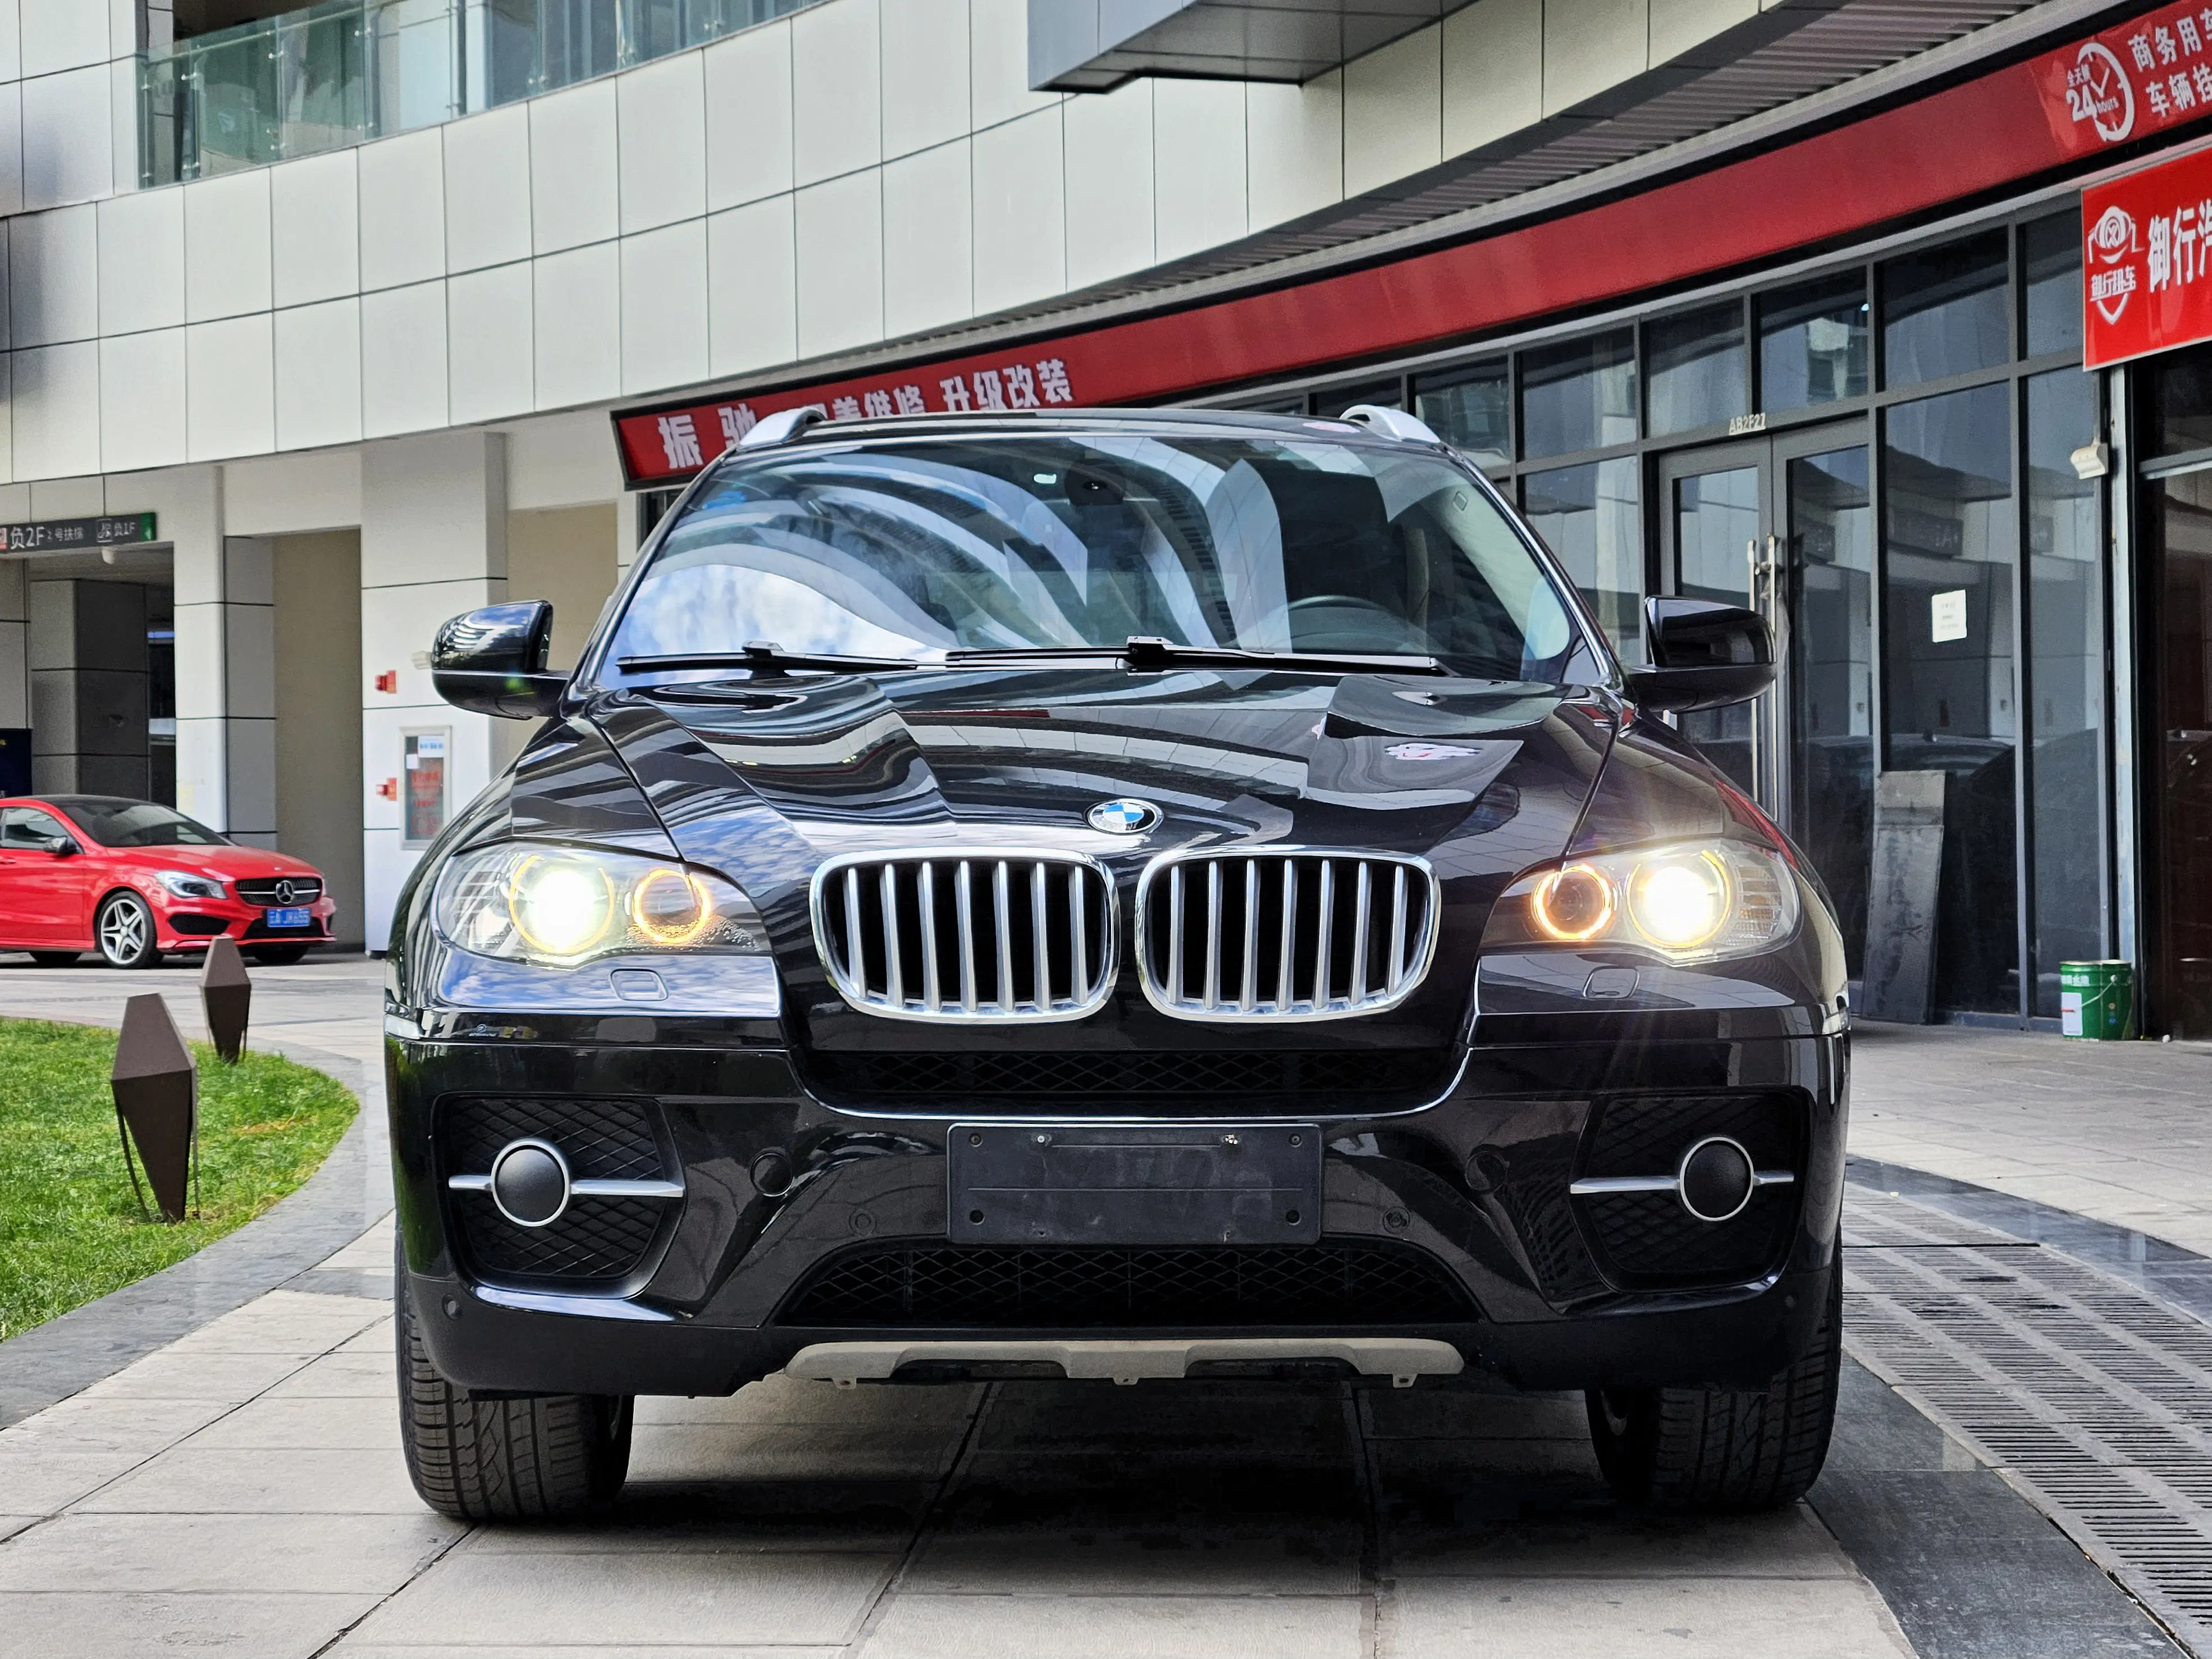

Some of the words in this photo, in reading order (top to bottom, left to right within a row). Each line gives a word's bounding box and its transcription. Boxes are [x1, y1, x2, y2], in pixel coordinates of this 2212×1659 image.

[2066, 85, 2097, 121] 24
[2095, 96, 2119, 114] hours
[939, 358, 1073, 411] 升级改装
[11, 526, 44, 550] 负2F
